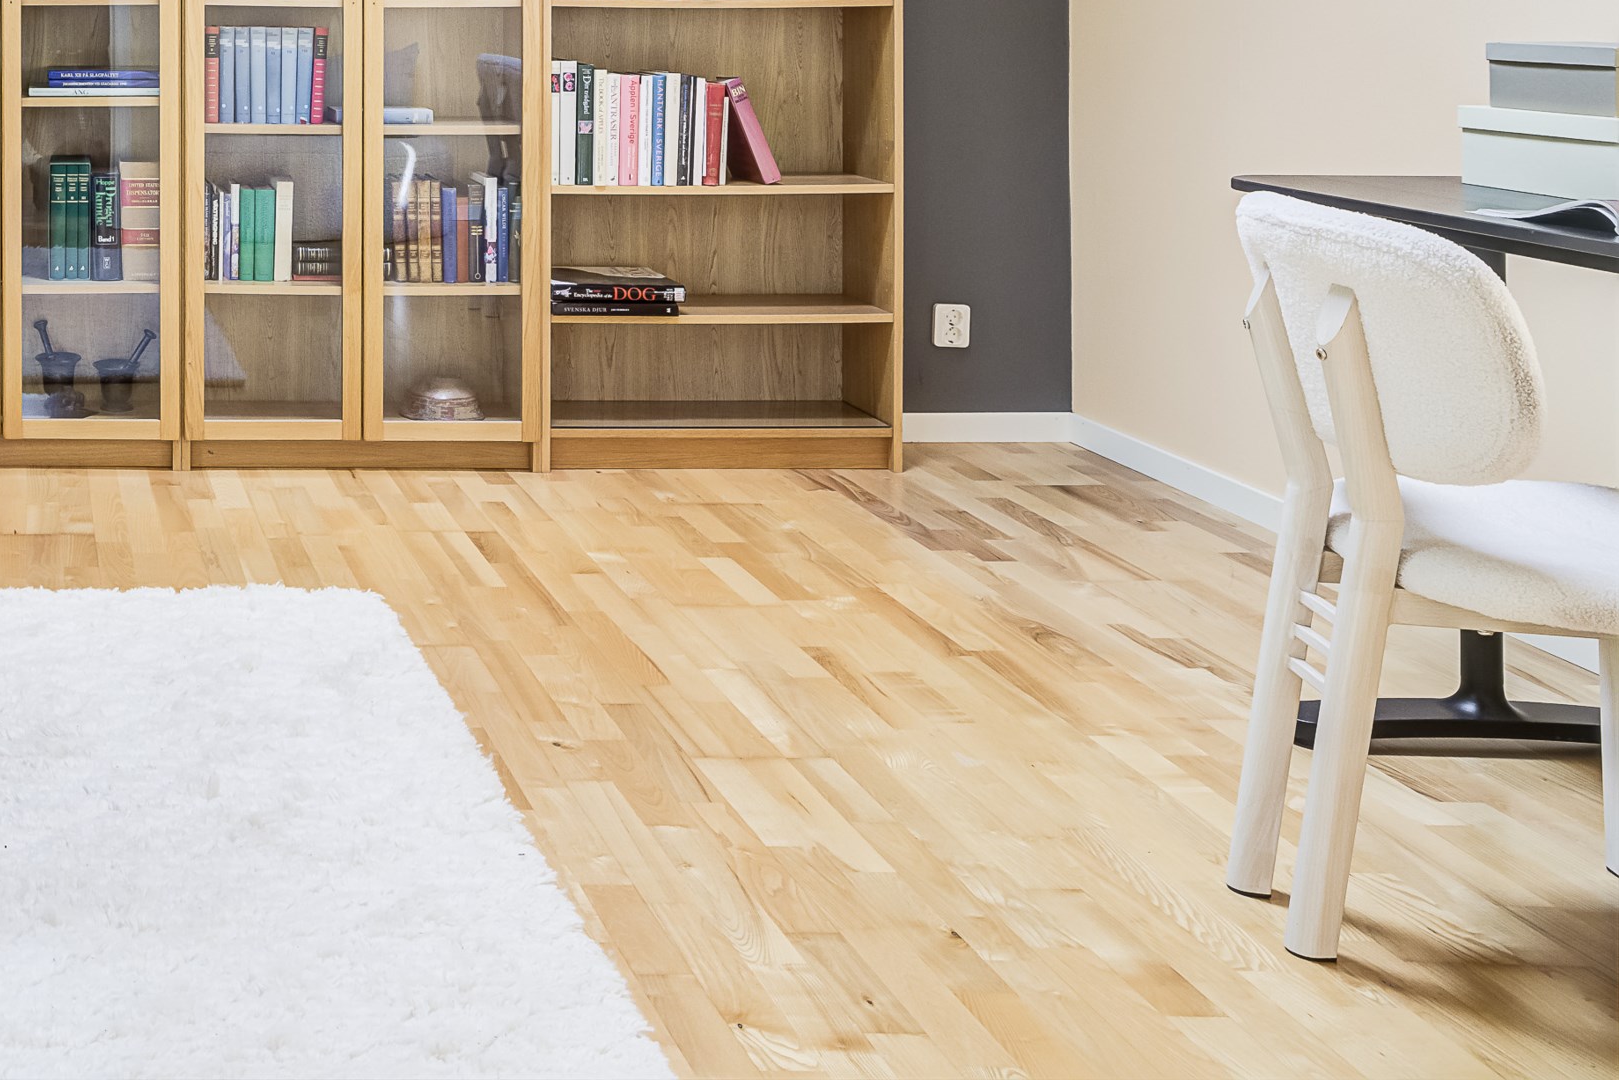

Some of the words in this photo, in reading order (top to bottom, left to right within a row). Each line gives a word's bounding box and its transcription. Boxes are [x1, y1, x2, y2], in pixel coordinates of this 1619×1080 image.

[731, 84, 747, 97] BIN
[656, 79, 664, 130] HANTVERK
[627, 114, 637, 144] Sverige
[655, 139, 663, 177] SVERIGE
[98, 235, 112, 243] Band
[613, 286, 657, 301] DOG
